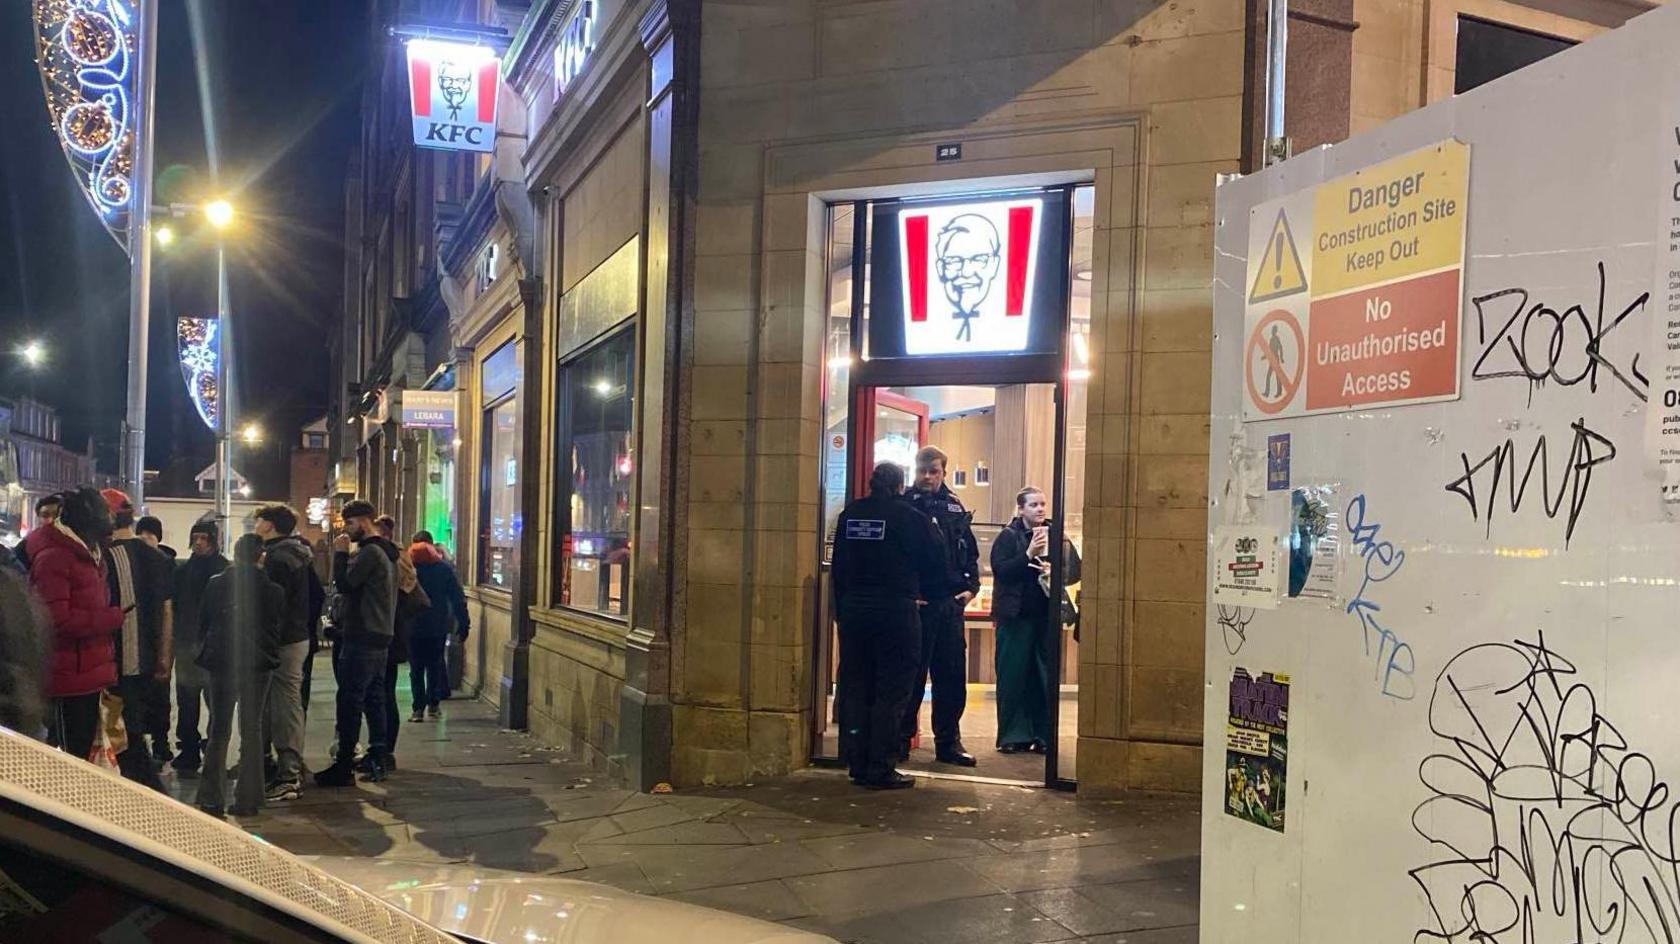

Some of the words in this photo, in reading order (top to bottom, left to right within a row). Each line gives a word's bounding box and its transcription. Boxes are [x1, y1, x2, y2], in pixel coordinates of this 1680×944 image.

[425, 122, 483, 145] KFC
[940, 147, 957, 157] 25
[1348, 171, 1425, 214] Danger
[1318, 210, 1416, 252] Construction
[1422, 199, 1456, 223] Site
[1345, 249, 1384, 272] Keep
[1389, 237, 1420, 261] Out
[1365, 296, 1392, 323] No
[1316, 320, 1446, 365] Unauthorised
[1341, 369, 1411, 397] Access
